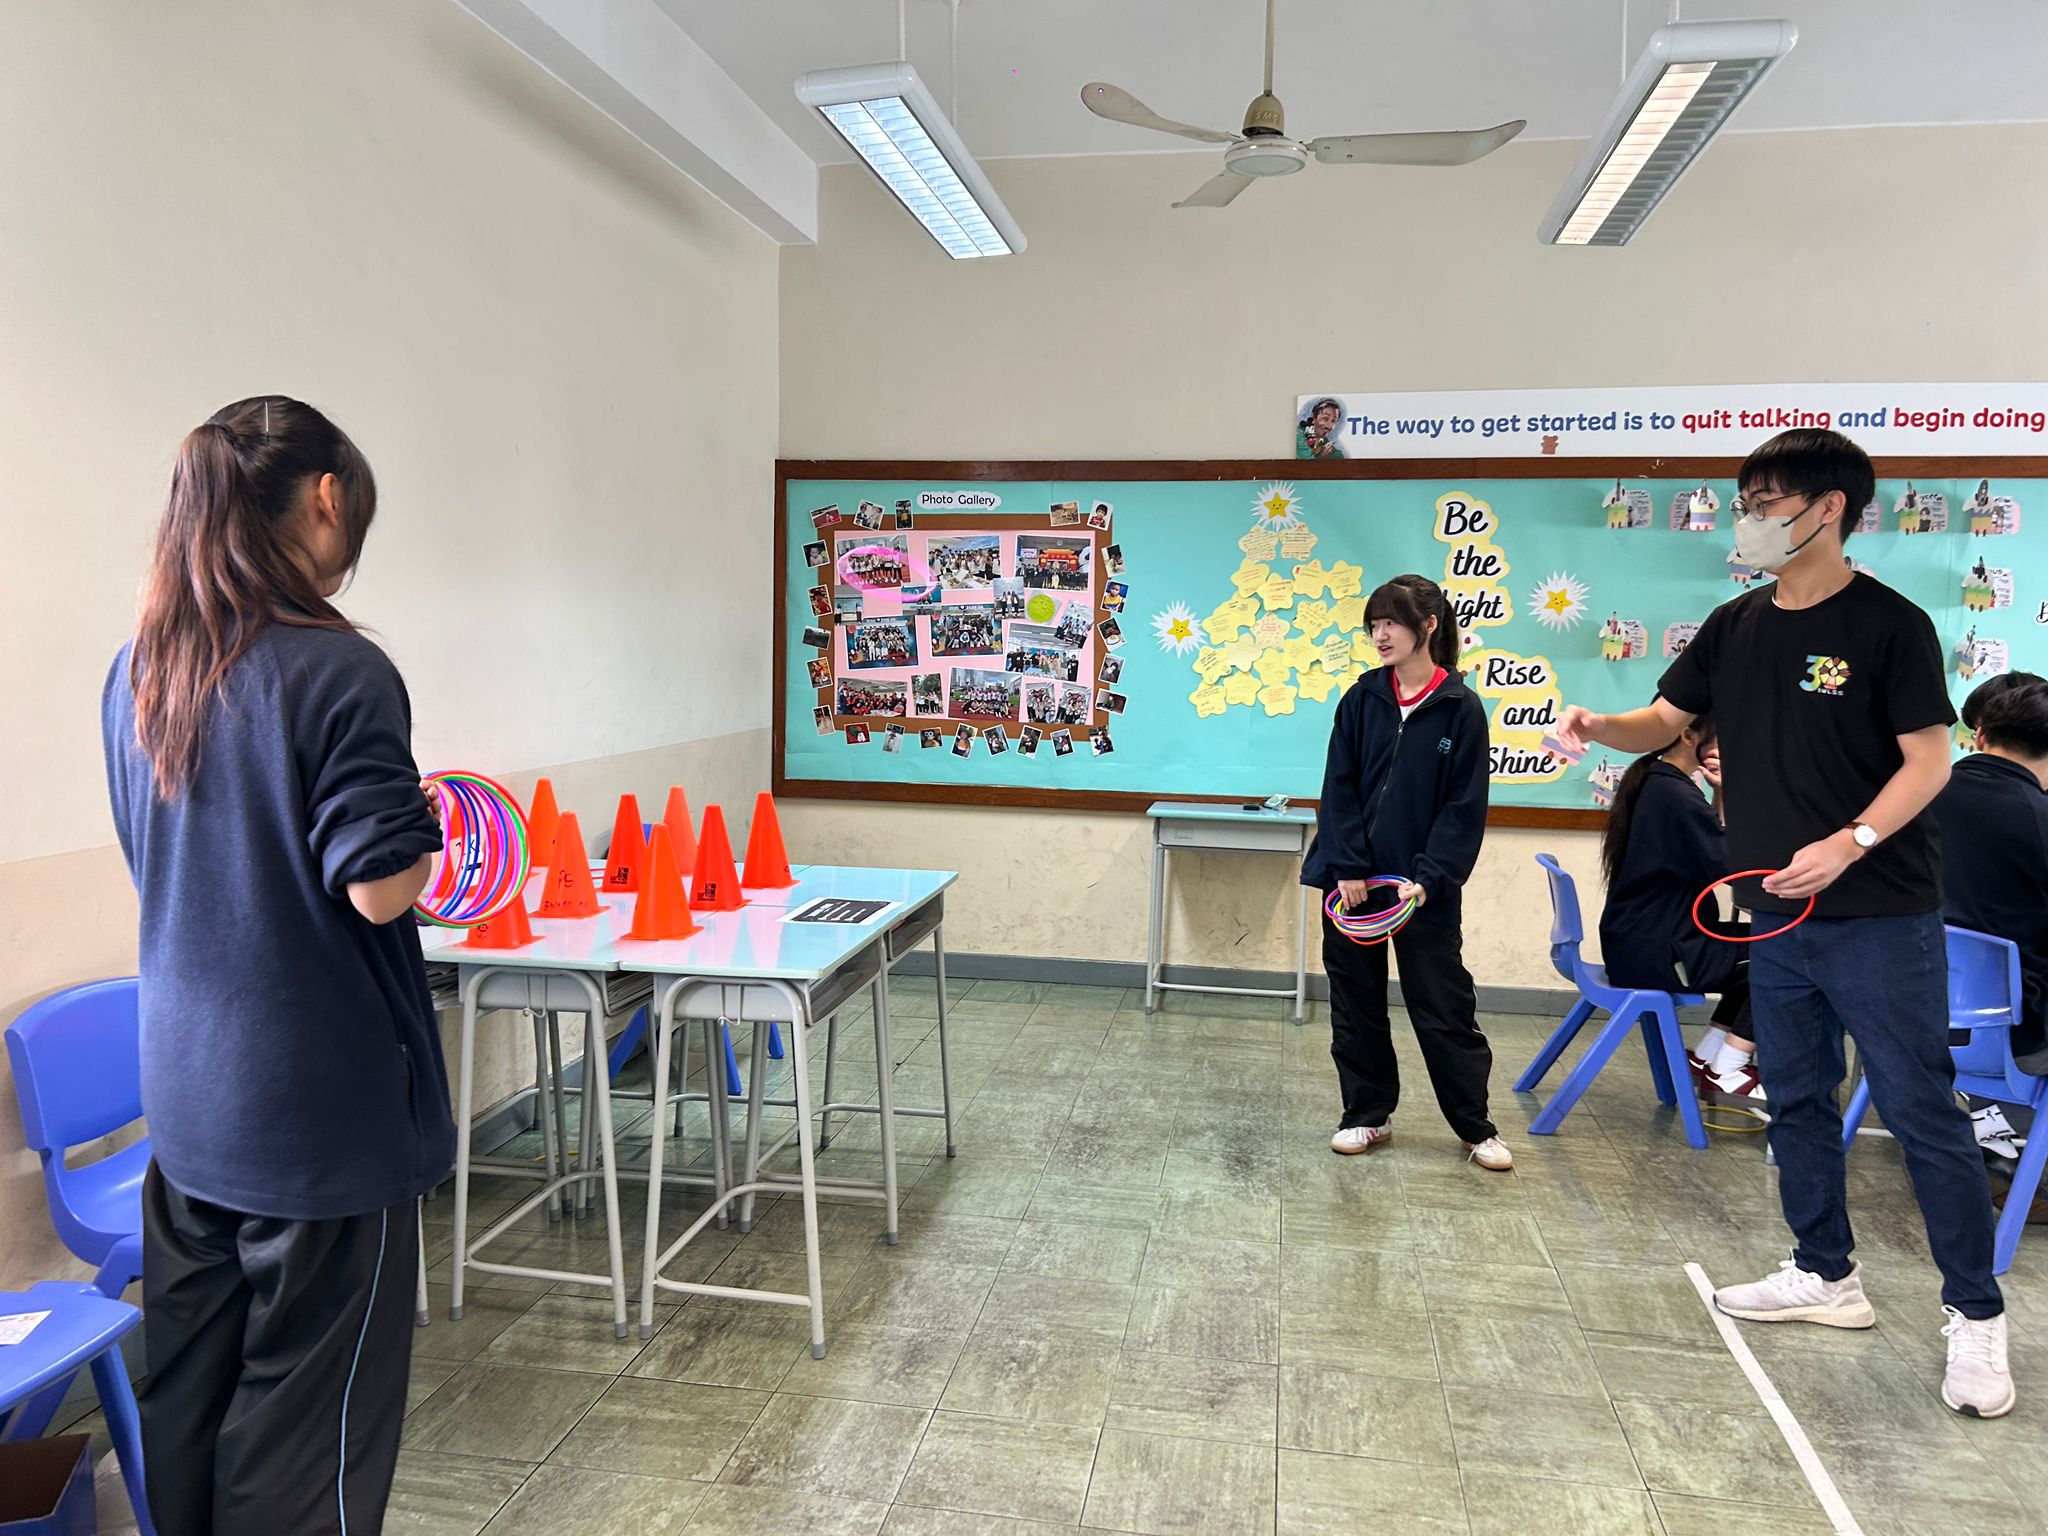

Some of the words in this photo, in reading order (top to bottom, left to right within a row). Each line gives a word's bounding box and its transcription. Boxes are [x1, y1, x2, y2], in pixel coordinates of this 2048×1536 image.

[1347, 416, 1391, 435] The
[1396, 418, 1444, 438] way
[1450, 416, 1475, 433] to
[1481, 414, 1521, 437] get
[1526, 412, 1617, 432] started
[1623, 411, 1643, 430] is
[1650, 411, 1676, 430] to
[1681, 410, 1732, 433] quit
[1738, 408, 1831, 430] talking
[1838, 407, 1887, 427] and
[1893, 407, 1965, 432] begin
[1972, 407, 2046, 433] doing
[921, 494, 954, 505] Photo
[958, 494, 996, 507] Gallery
[1443, 501, 1489, 535] Be
[1452, 545, 1502, 577] the
[1485, 658, 1546, 688] Rise
[1503, 699, 1556, 726] and
[1488, 745, 1557, 776] Shine
